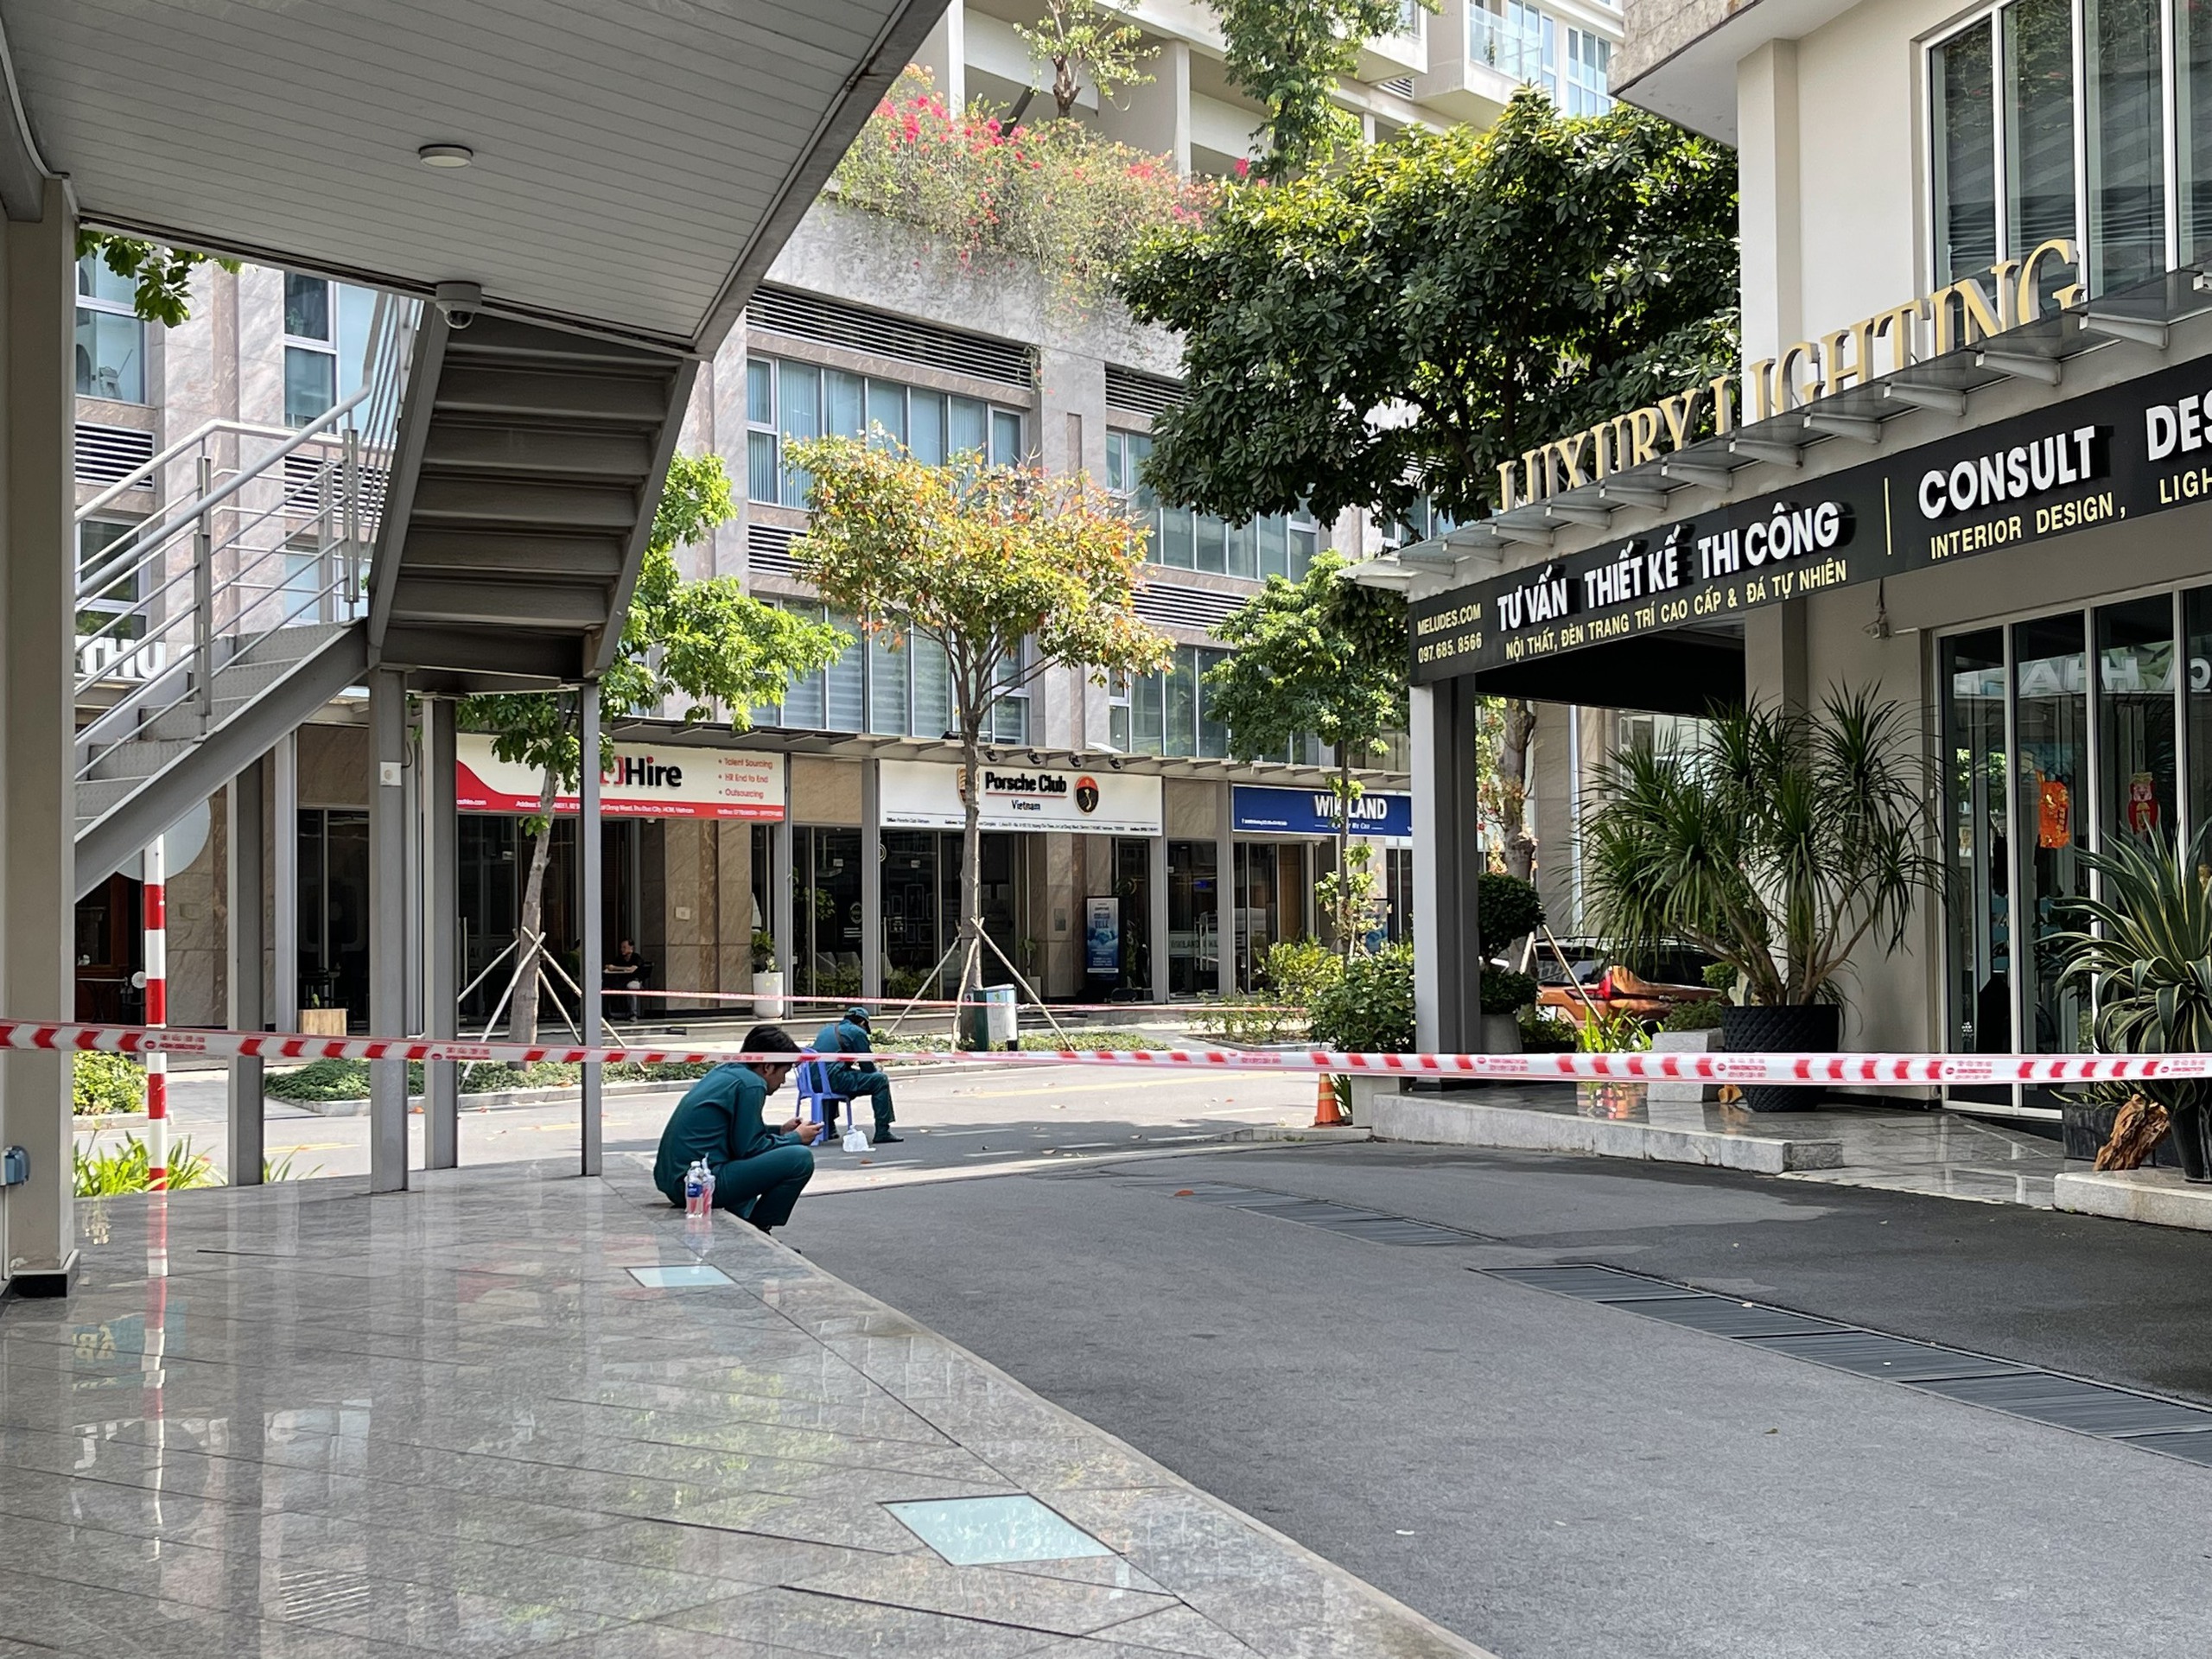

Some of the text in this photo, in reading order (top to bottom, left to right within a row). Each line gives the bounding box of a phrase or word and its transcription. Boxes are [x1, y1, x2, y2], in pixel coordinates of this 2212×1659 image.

[1497, 238, 2087, 512] LUXURY LIGHTING
[1918, 425, 2095, 519] CONSULT
[1930, 515, 2023, 560] INTERIOR
[1497, 501, 1840, 632] TƯ VẤN THIẾT KẾ THI CÔNG
[1417, 603, 1482, 637] MELUDES.COM
[1506, 638, 1524, 663] NỘI
[1560, 622, 1584, 647] ĐÈN
[1587, 613, 1630, 641] TRANG
[1635, 601, 1656, 629] TRÍ
[1661, 599, 1688, 623] CAO
[1694, 585, 1722, 615] CẤP
[1727, 588, 1738, 608] &
[1745, 575, 1766, 604] ĐÁ
[1771, 571, 1794, 600] TỰ
[1799, 557, 1847, 592] NHIÊN
[724, 757, 773, 770] Talent Sourcing
[748, 774, 755, 783] to
[756, 775, 769, 784] End
[724, 788, 764, 799] Outsourcing
[985, 771, 1067, 793] Porsche Club
[1011, 799, 1041, 810] Vietnam
